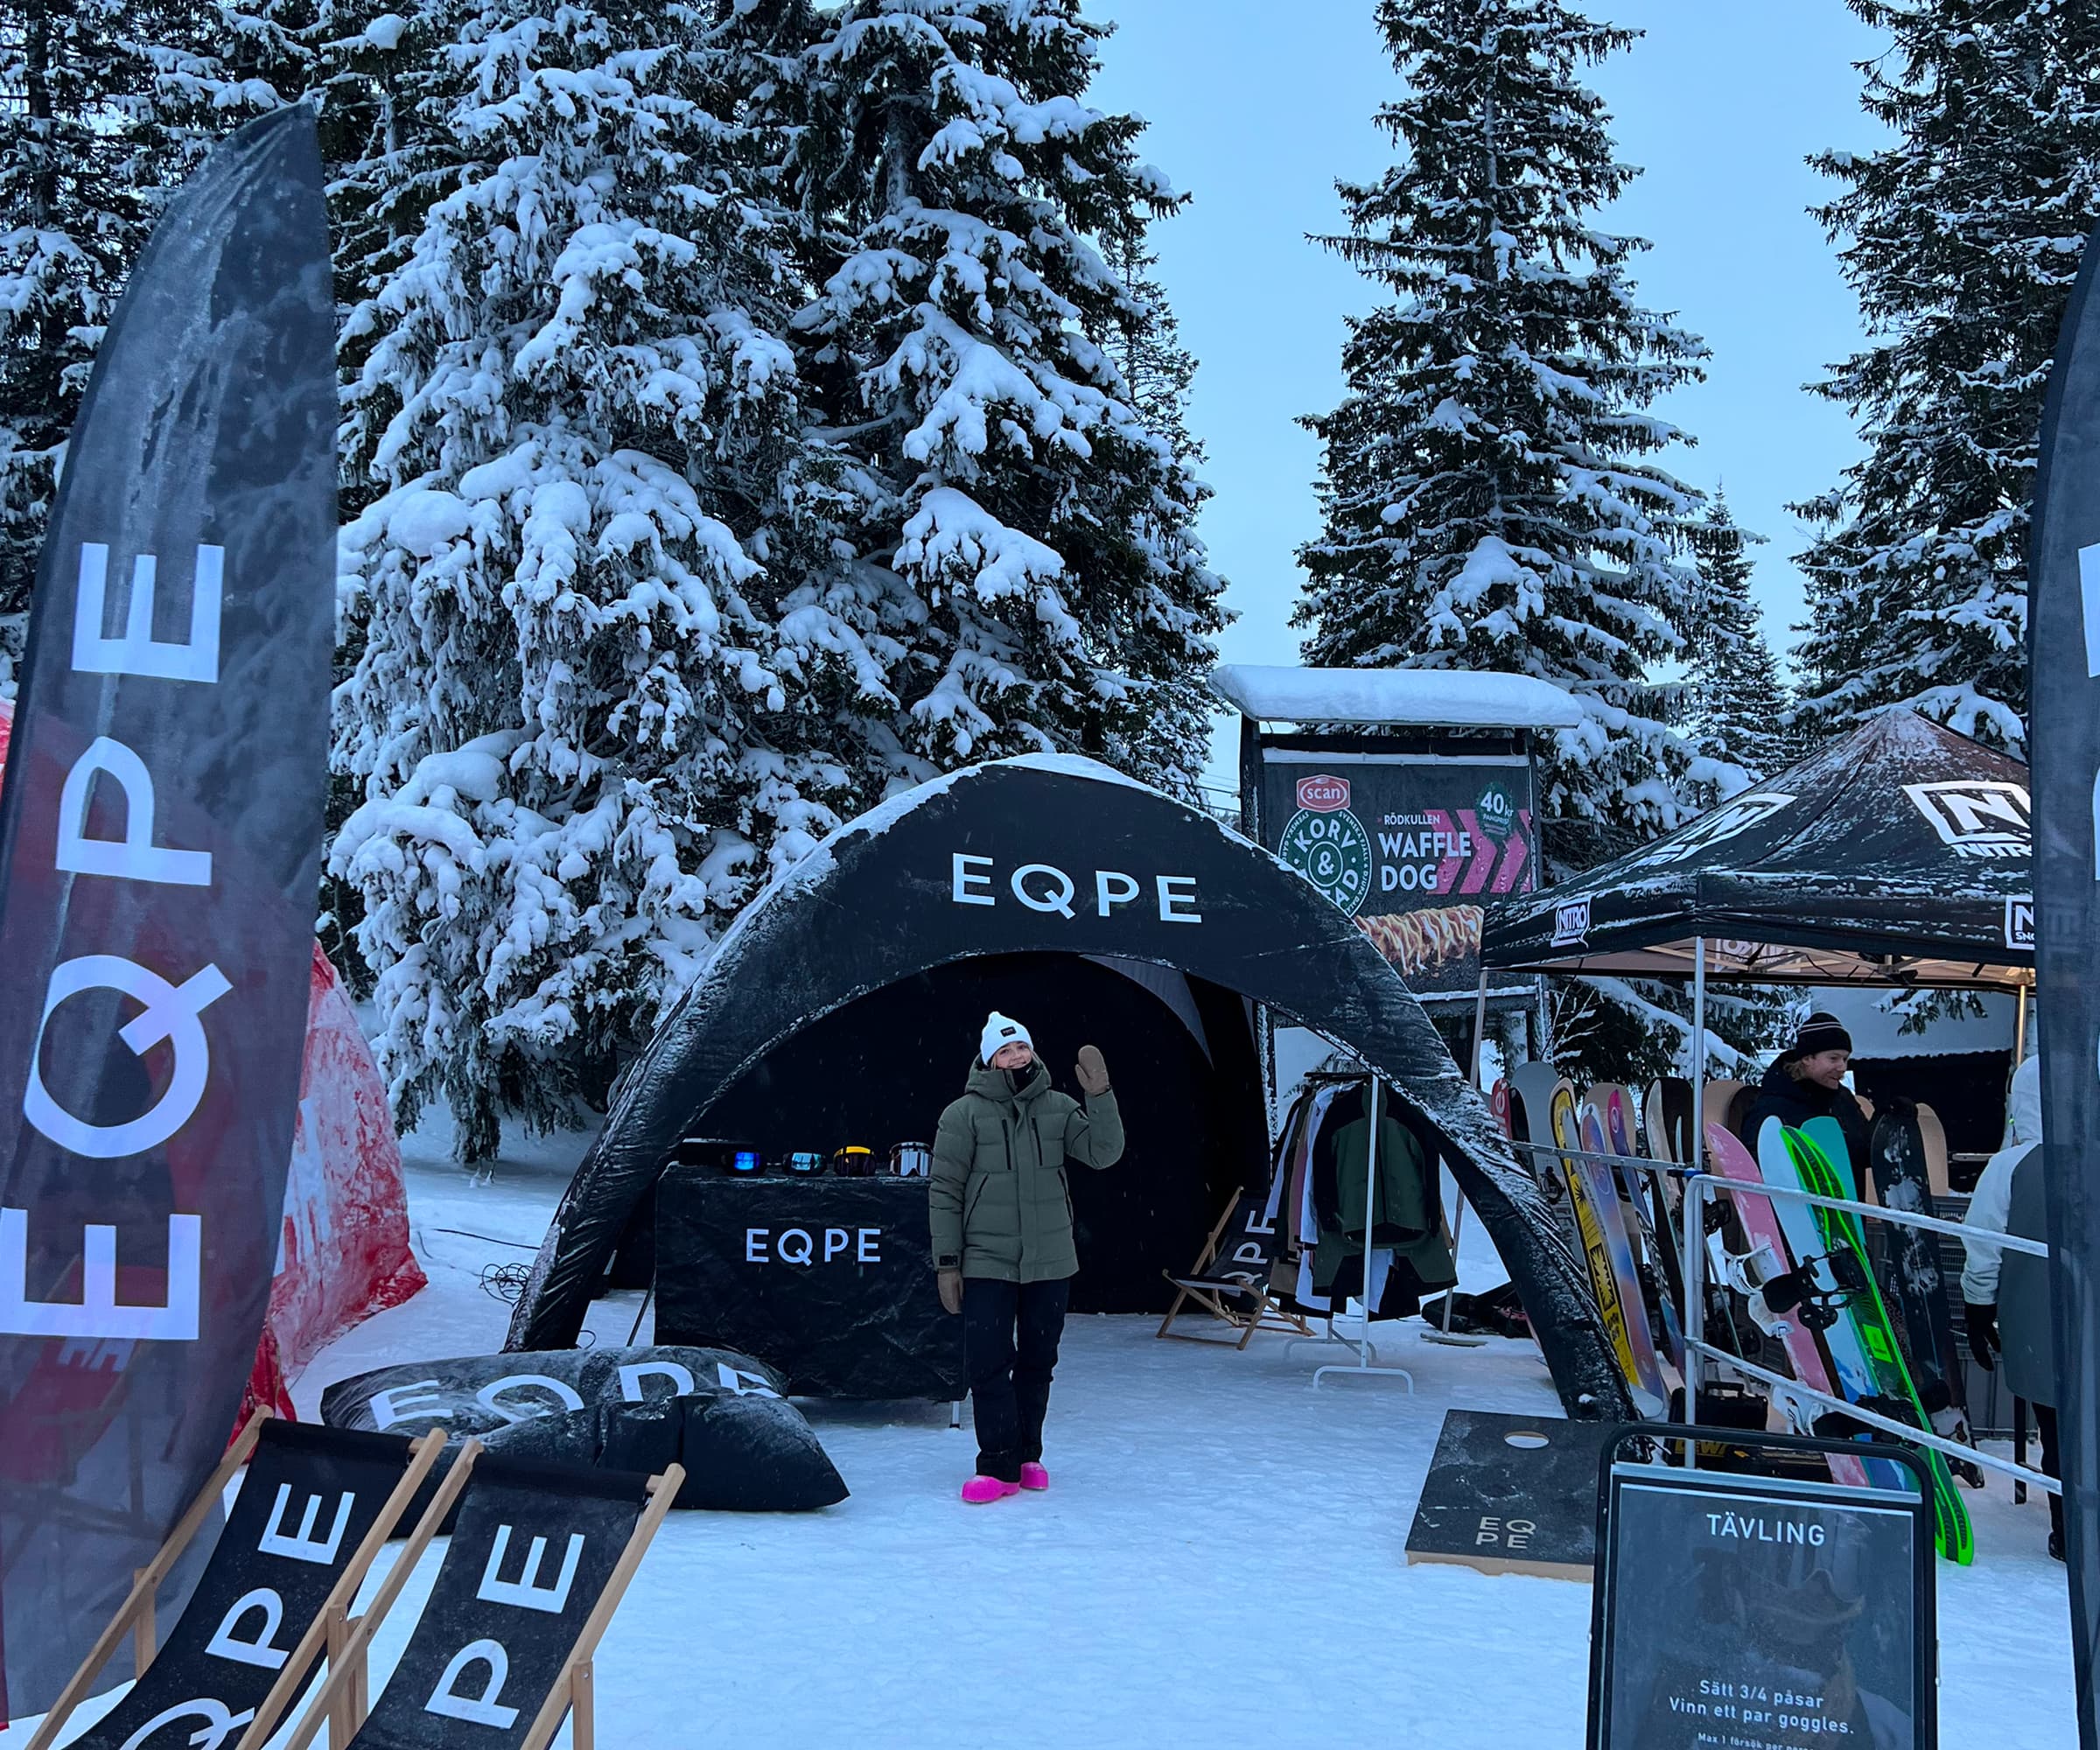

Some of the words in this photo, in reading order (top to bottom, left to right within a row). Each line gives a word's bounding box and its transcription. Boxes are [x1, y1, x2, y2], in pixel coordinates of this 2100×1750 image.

[1306, 787, 1340, 800] scan
[1480, 791, 1504, 814] 40
[1384, 812, 1440, 825] RÖDKULLEN
[1293, 818, 1357, 853] KORV
[1378, 832, 1471, 858] WAFFLE
[1317, 850, 1334, 876] &
[1950, 843, 2032, 858] NITR
[952, 852, 1202, 923] EQPE
[1381, 864, 1437, 891] DOG
[0, 542, 233, 1340] EQPE
[746, 1228, 882, 1266] EQPE
[1480, 1516, 1536, 1535] EQ
[1705, 1511, 1826, 1547] TÄVLING
[1475, 1532, 1530, 1549] PE
[1699, 1679, 1733, 1698] Sätt
[1740, 1684, 1768, 1702] 3/4
[1773, 1689, 1824, 1710] påsar
[1669, 1697, 1707, 1716] Vinn
[1713, 1704, 1737, 1719] ett
[1743, 1710, 1773, 1724] par
[1778, 1714, 1855, 1735] goggles.
[1698, 1732, 1718, 1744] Max
[1722, 1735, 1726, 1745] 1
[1729, 1736, 1763, 1749] försök
